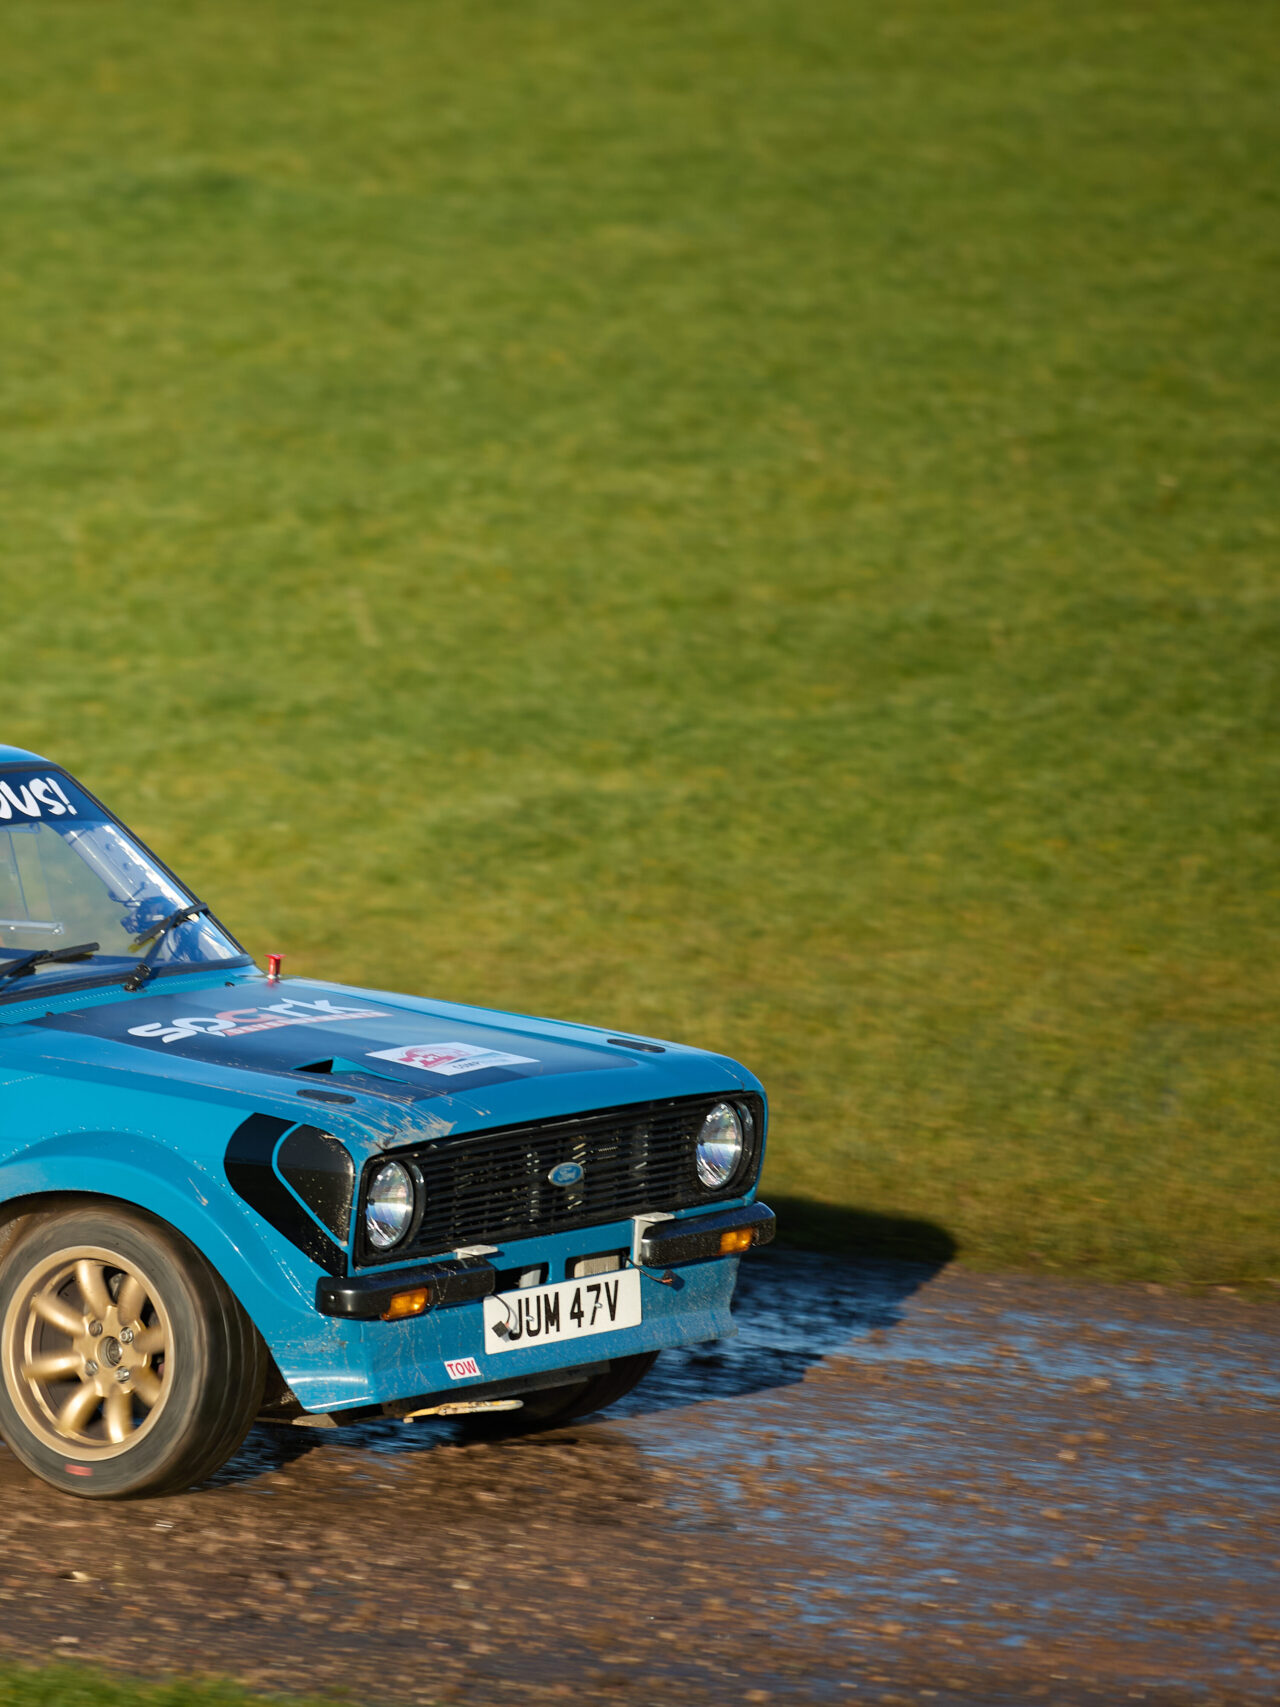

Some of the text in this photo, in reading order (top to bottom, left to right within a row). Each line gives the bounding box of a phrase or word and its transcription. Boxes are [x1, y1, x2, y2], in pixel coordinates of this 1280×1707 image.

[508, 1279, 619, 1342] JUM 47V
[446, 1359, 478, 1377] TOW
